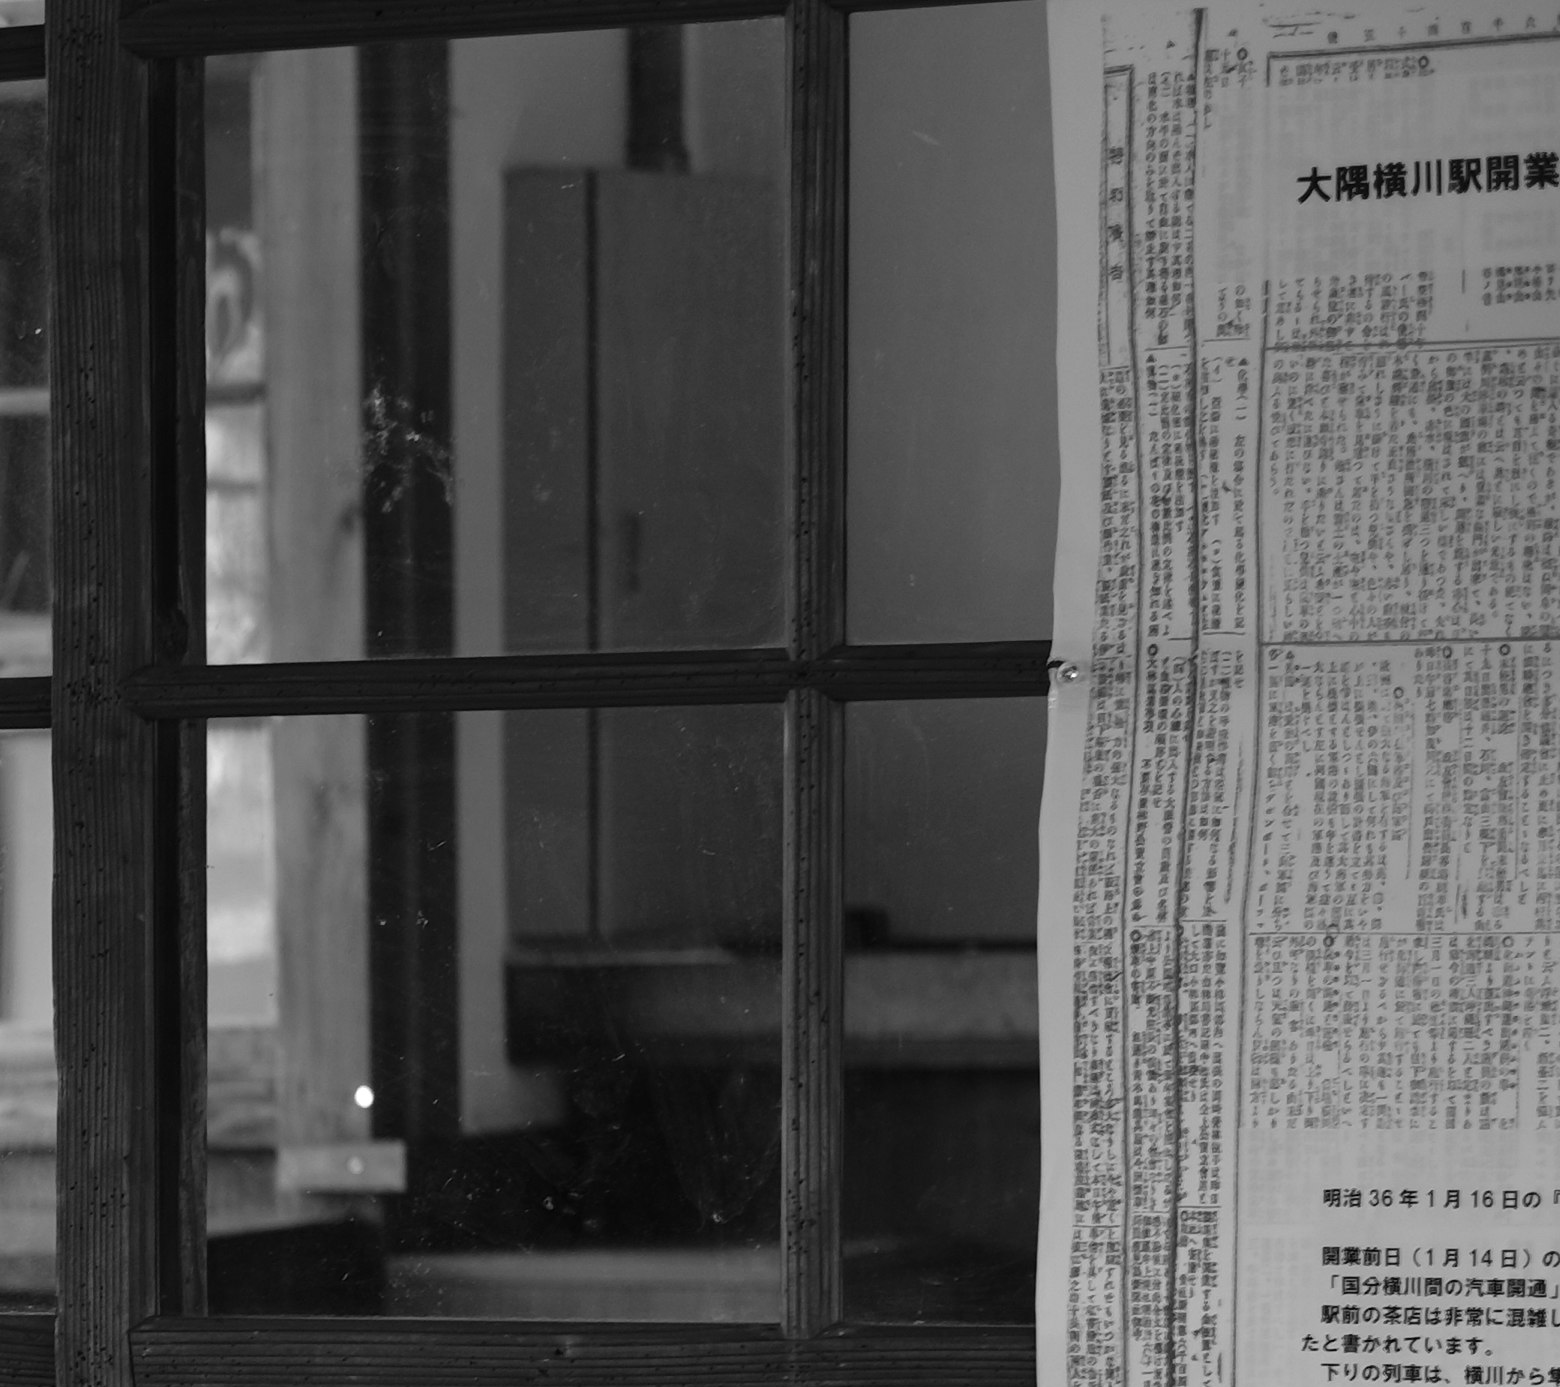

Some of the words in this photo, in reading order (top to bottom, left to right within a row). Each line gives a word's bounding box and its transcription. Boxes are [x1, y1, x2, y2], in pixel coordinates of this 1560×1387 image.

[1296, 151, 1560, 206] 大隅横川駅開業
[1301, 1333, 1494, 1357] たと書かれています。
